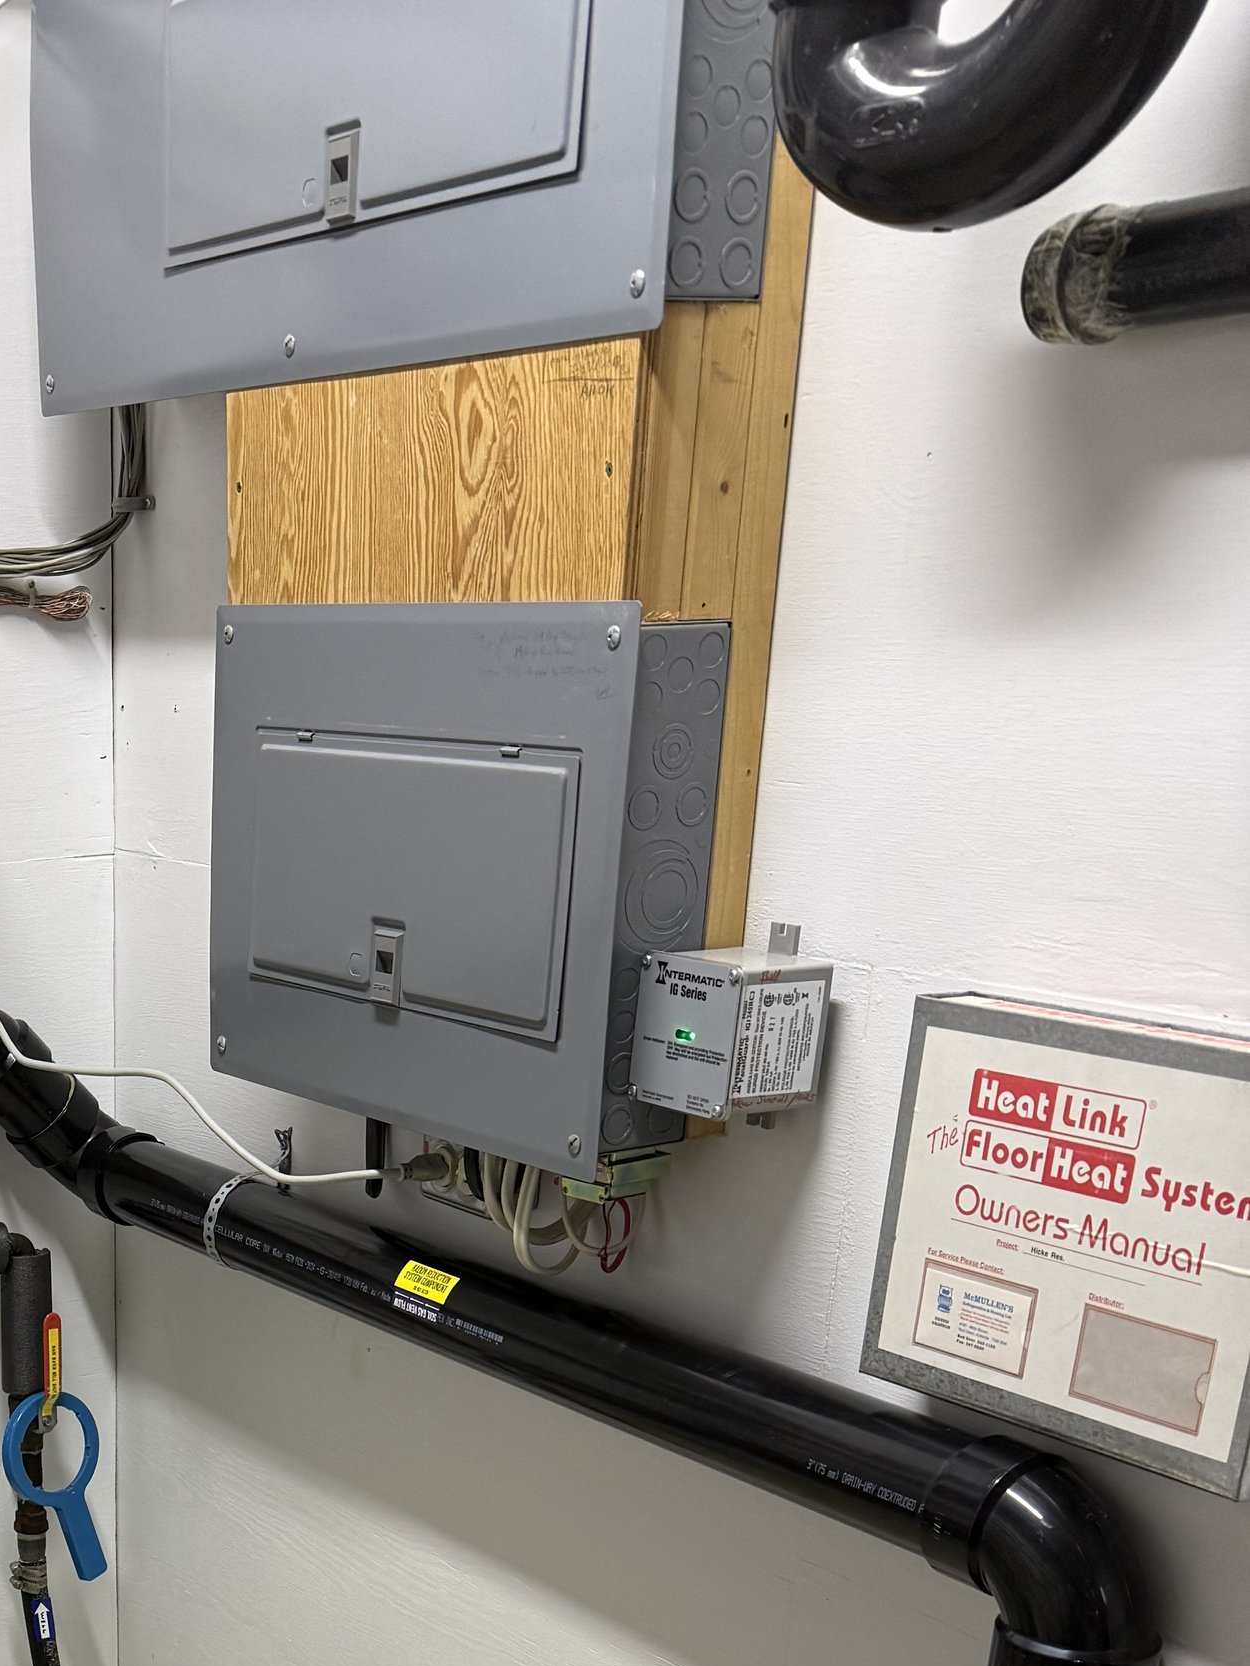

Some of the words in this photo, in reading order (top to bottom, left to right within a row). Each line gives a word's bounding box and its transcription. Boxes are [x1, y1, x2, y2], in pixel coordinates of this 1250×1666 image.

[655, 960, 725, 988] INTERMATIC
[670, 983, 678, 995] IG
[680, 984, 707, 1001] Series
[977, 1078, 1050, 1121] Heat
[1063, 1095, 1129, 1137] Link
[927, 1127, 959, 1153] The
[965, 1128, 1043, 1173] Floor
[1051, 1147, 1128, 1193] Heat
[955, 1184, 1069, 1240] Owners
[1078, 1214, 1207, 1275] Manual
[928, 1247, 939, 1257] For
[939, 1250, 959, 1262] Service
[960, 1256, 978, 1267] Please
[996, 1238, 1020, 1252] Project:
[1031, 1246, 1049, 1257] Hicke
[1051, 1252, 1066, 1262] Res.
[404, 1271, 422, 1283] SYSTEM
[963, 1291, 1014, 1313] McMULLEN'S
[1089, 1292, 1124, 1309] Distributor:
